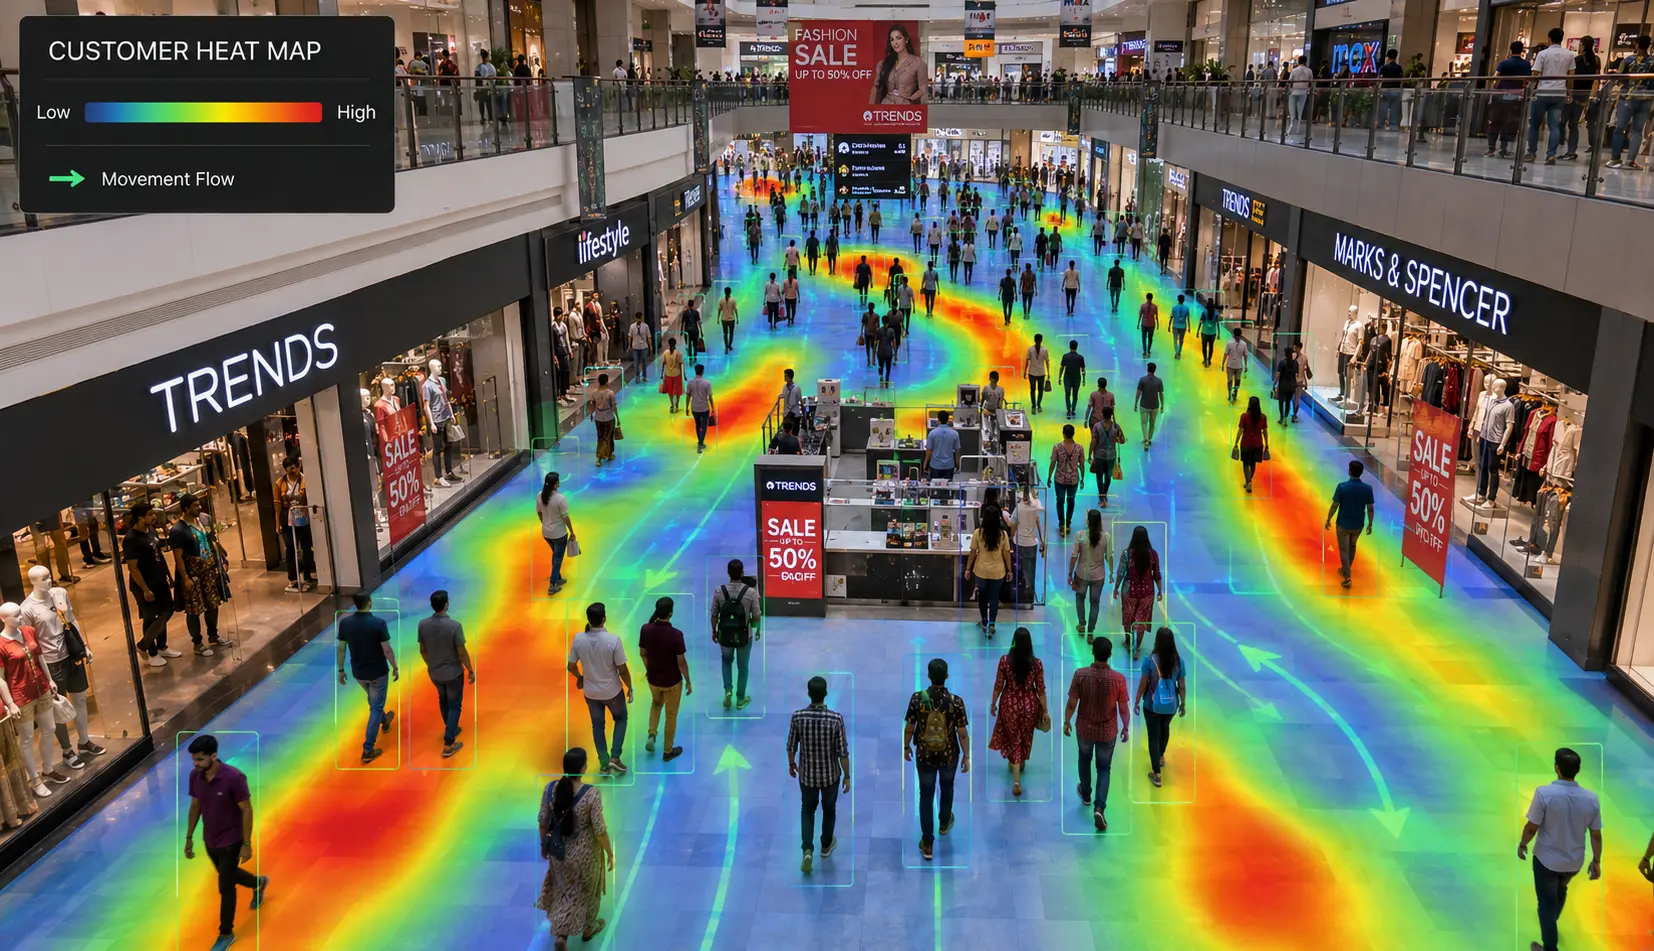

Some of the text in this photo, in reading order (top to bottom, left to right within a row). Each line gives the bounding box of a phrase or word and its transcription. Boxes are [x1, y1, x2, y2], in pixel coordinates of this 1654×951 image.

[795, 28, 857, 41] FASHION
[795, 44, 857, 66] SALE
[1331, 41, 1380, 74] max
[795, 70, 873, 80] UP TO 50% OFF
[873, 110, 922, 121] TRENDS
[1222, 188, 1250, 219] TRENDS
[1334, 232, 1511, 335] MARKS & SPENCER
[150, 323, 338, 433] TRENDS
[385, 428, 417, 468] SALE
[1413, 429, 1452, 479] SALE
[389, 466, 420, 508] 50%
[775, 481, 817, 491] TRENDS
[1410, 479, 1445, 534] 50%
[768, 517, 816, 537] SALE
[769, 547, 817, 569] 50%
